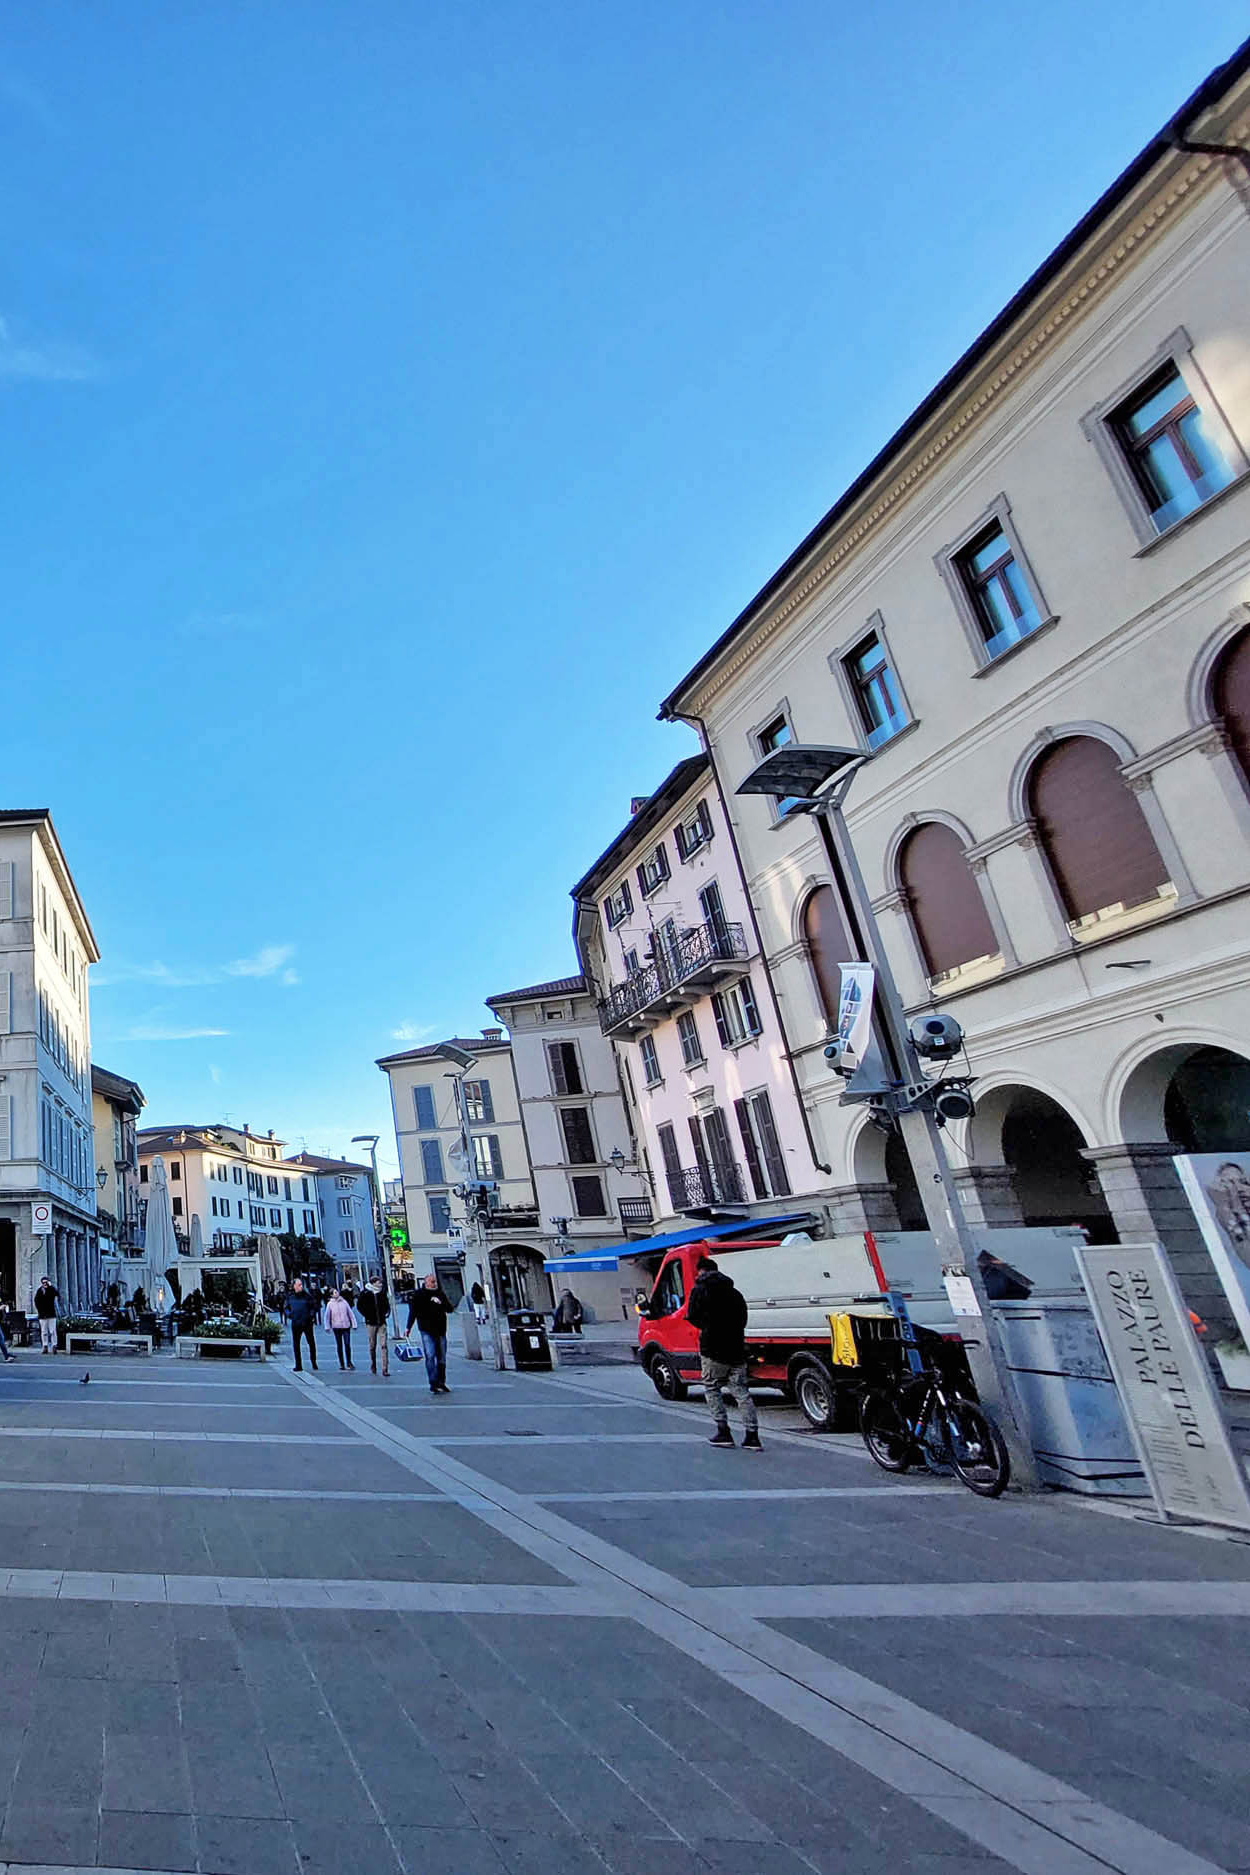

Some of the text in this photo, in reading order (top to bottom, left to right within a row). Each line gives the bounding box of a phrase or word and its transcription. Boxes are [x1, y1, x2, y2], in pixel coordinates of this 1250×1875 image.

[1106, 1270, 1158, 1385] PALAZZO
[1131, 1269, 1172, 1353] PAURE
[1158, 1360, 1206, 1450] DELLE
